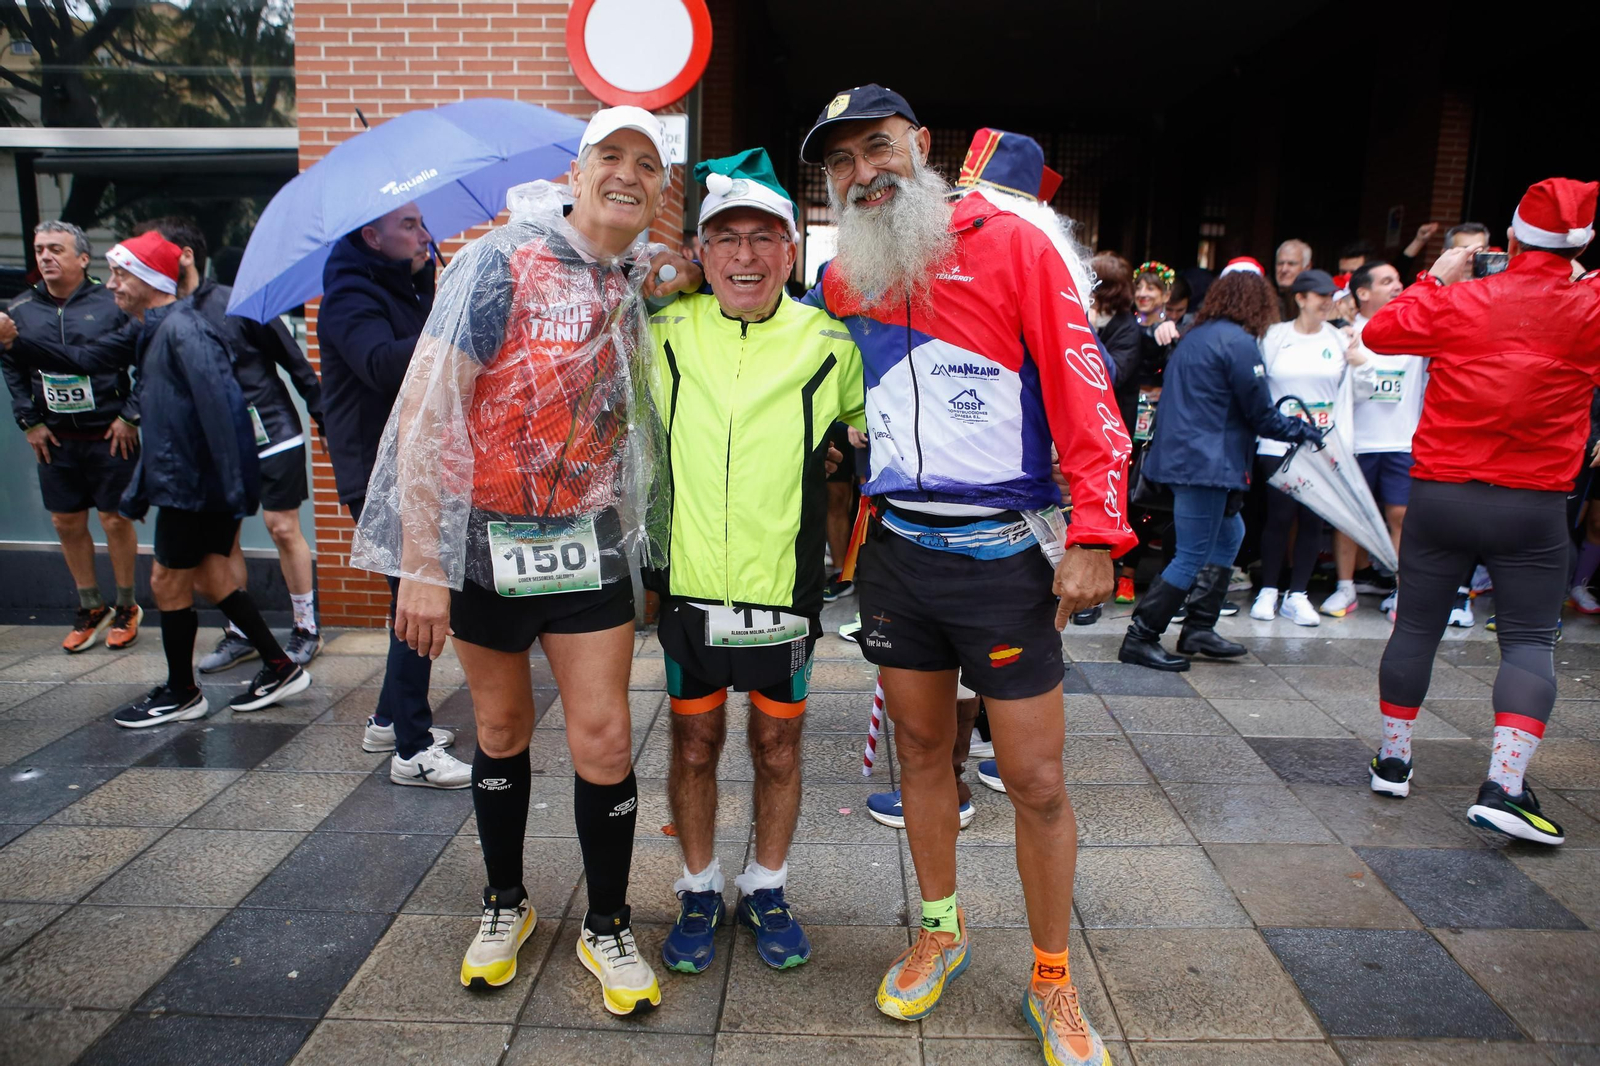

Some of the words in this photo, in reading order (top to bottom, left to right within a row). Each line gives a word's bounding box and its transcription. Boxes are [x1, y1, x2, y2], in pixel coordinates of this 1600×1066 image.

[392, 168, 438, 195] aqualia
[47, 387, 85, 402] 559
[503, 542, 587, 575] 150
[749, 628, 766, 636] MOLINA,
